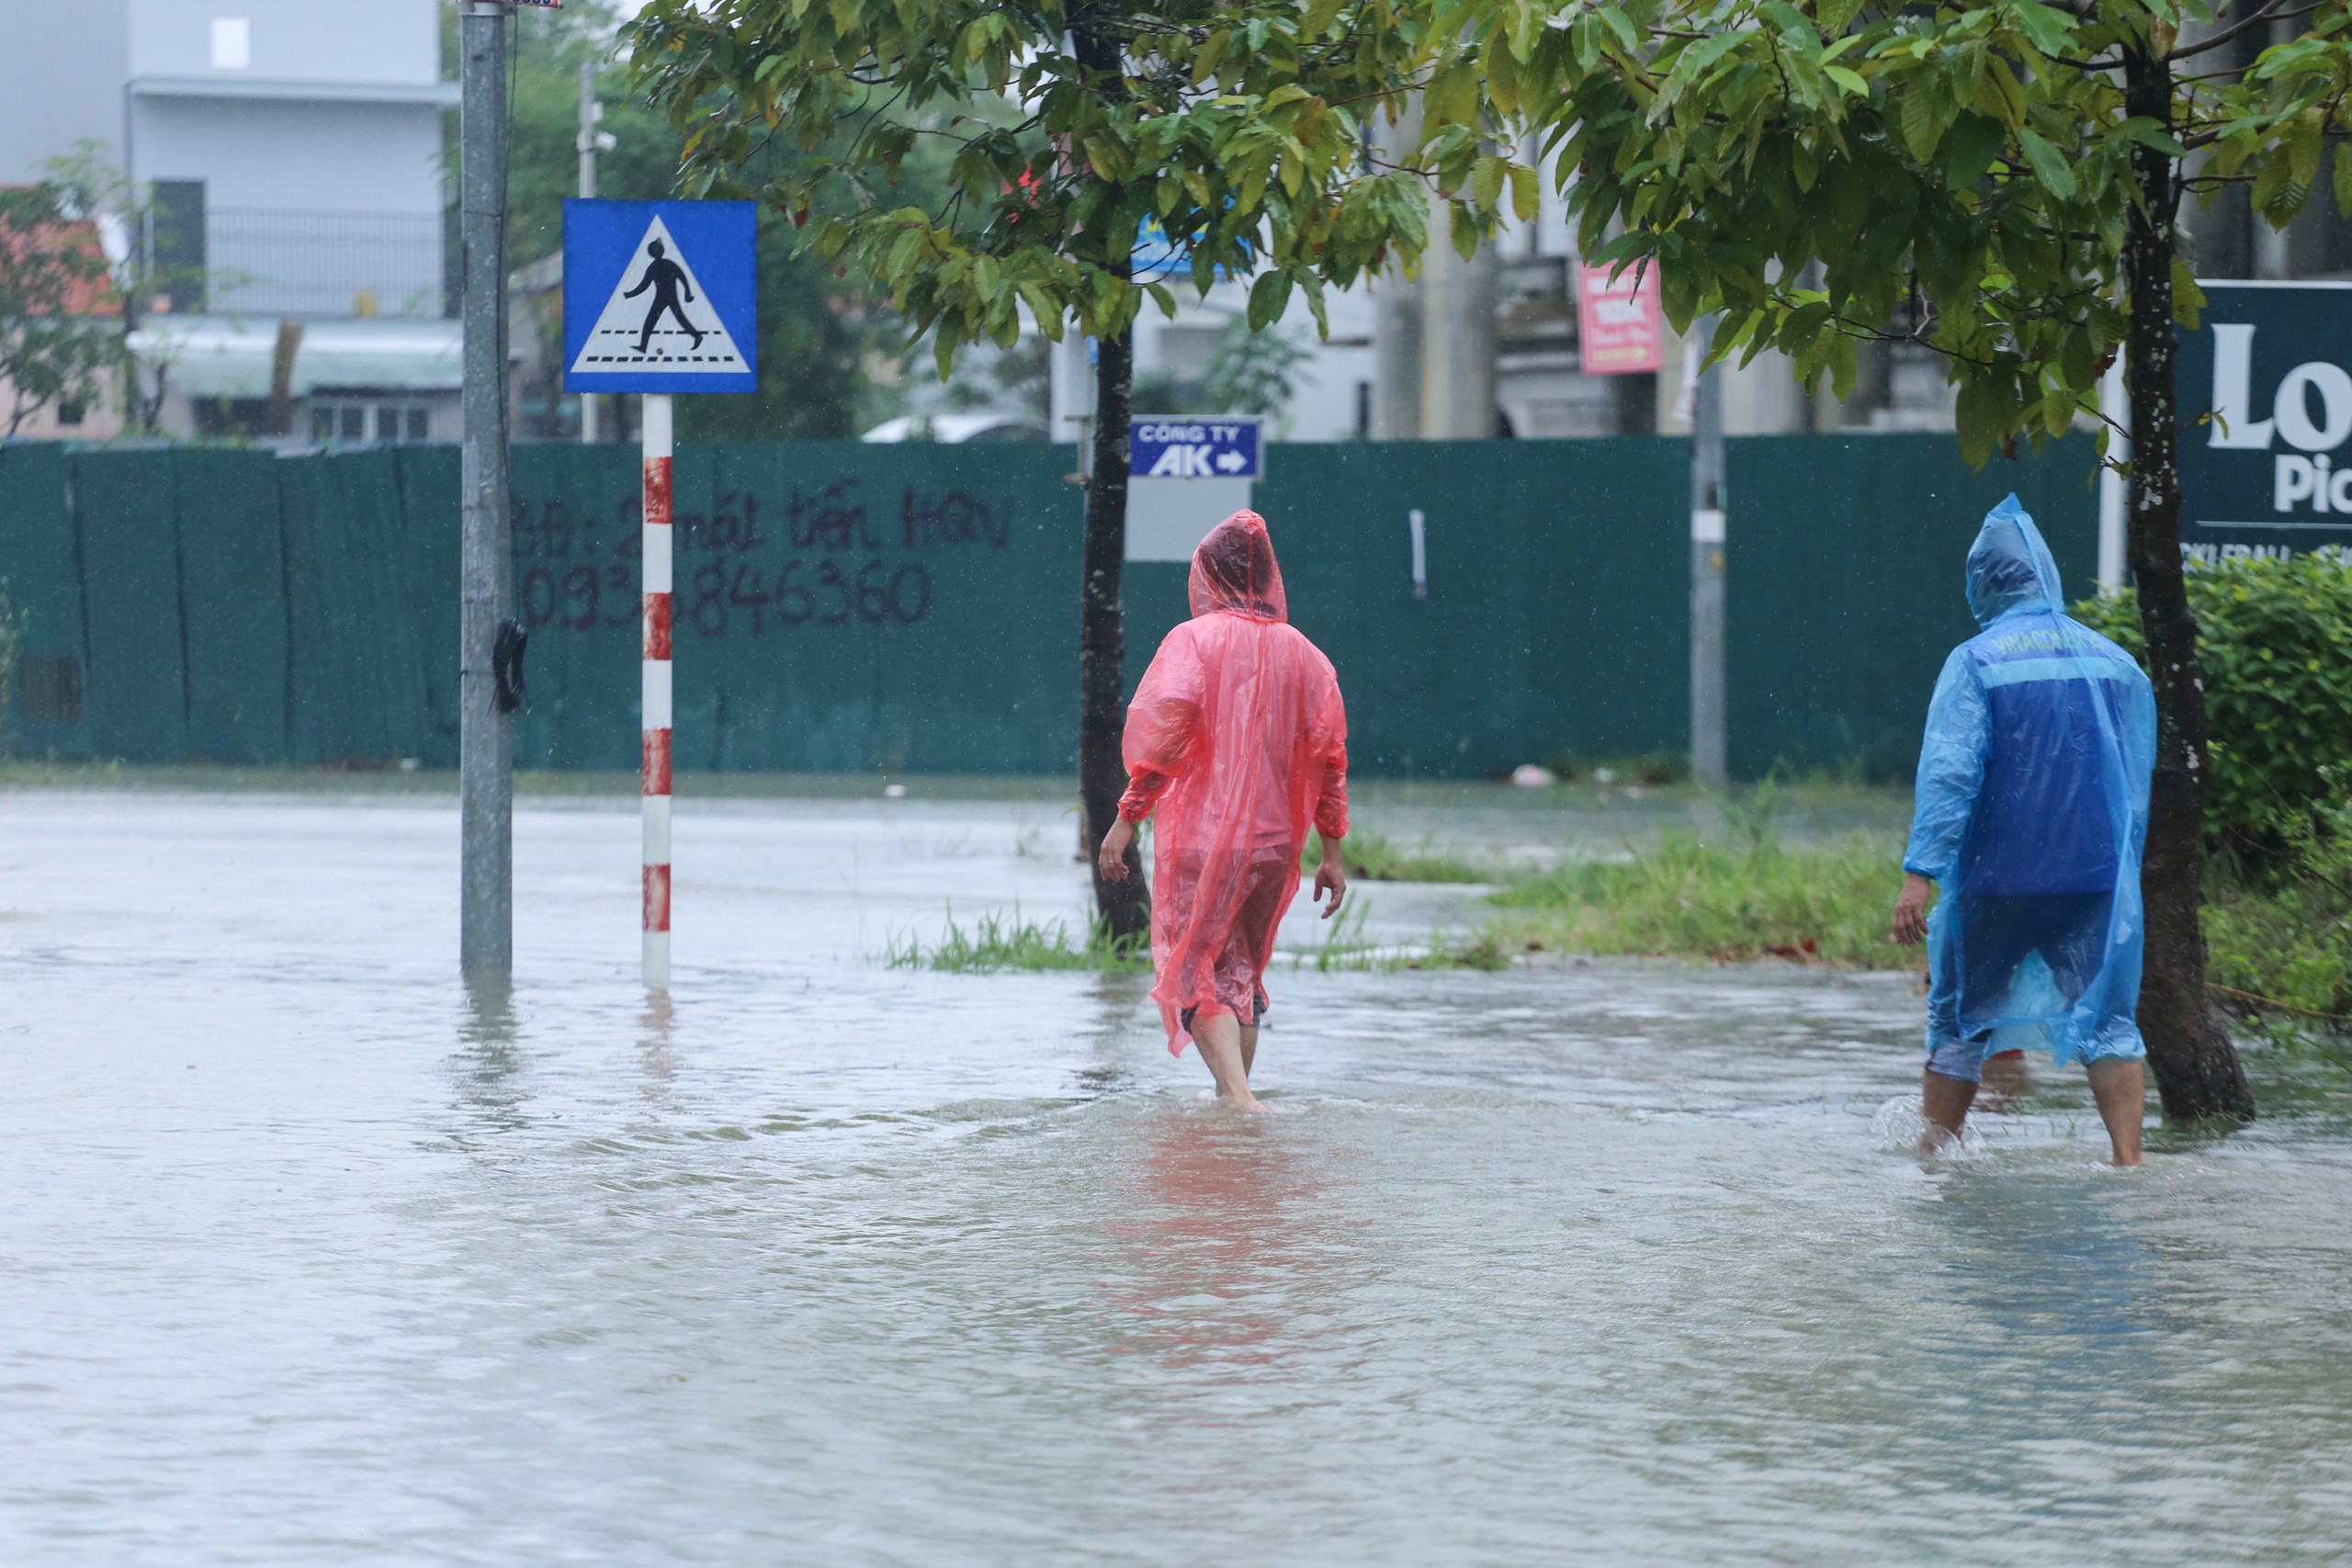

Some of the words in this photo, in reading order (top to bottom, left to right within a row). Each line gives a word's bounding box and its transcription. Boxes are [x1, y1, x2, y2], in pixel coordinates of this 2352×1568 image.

[1137, 422, 1206, 444] CÔNG
[1209, 425, 1239, 444] TY
[1148, 444, 1215, 477] AK
[524, 558, 932, 638] 093846360
